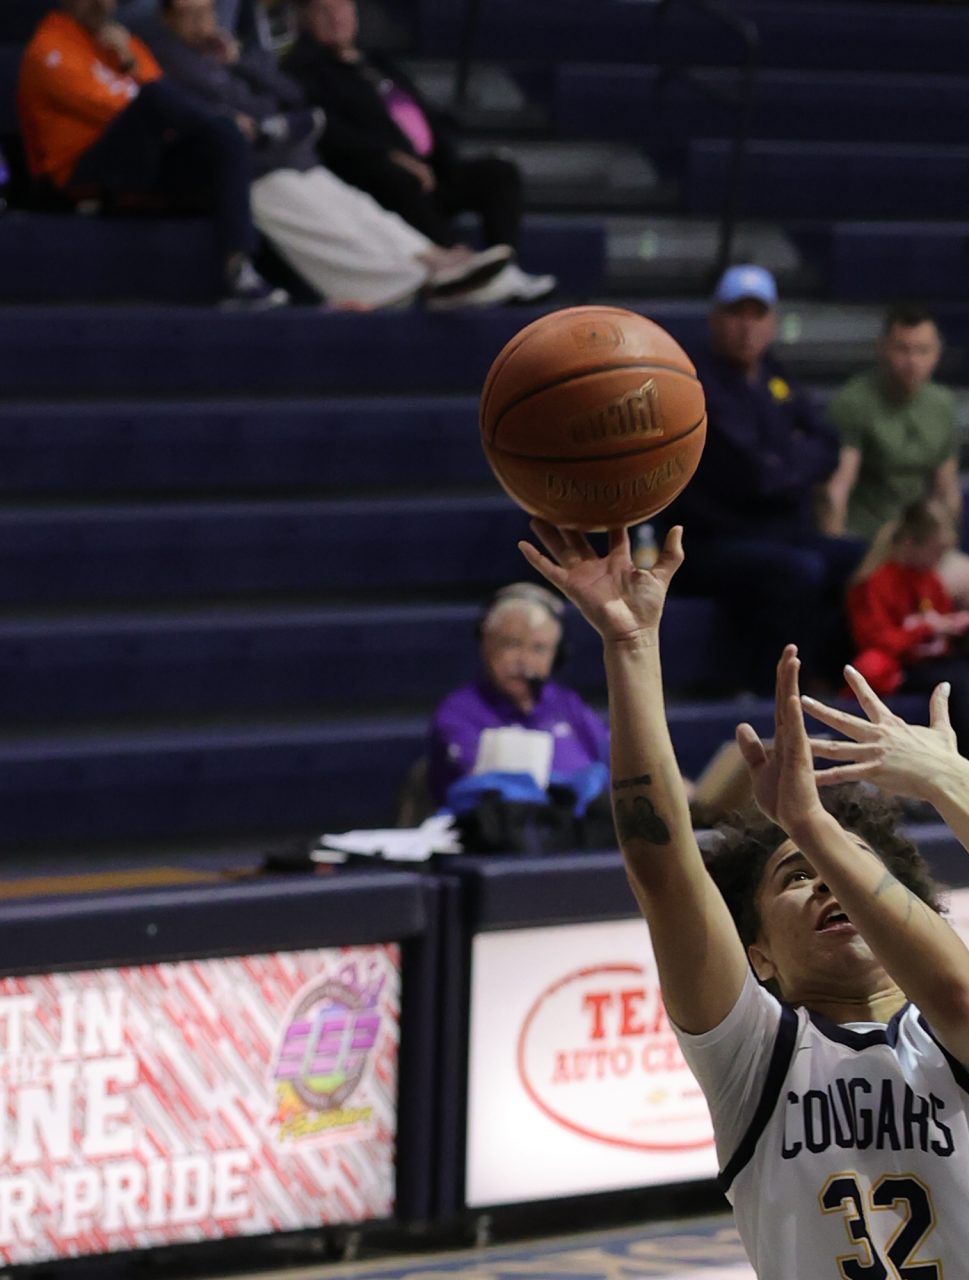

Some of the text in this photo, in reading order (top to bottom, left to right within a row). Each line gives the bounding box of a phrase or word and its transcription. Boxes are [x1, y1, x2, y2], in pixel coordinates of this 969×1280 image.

[60, 986, 124, 1056] IN
[553, 1047, 634, 1083] AUTO
[0, 1055, 137, 1162] NE
[781, 1077, 954, 1160] COUGARS
[60, 1150, 251, 1238] PRIDE
